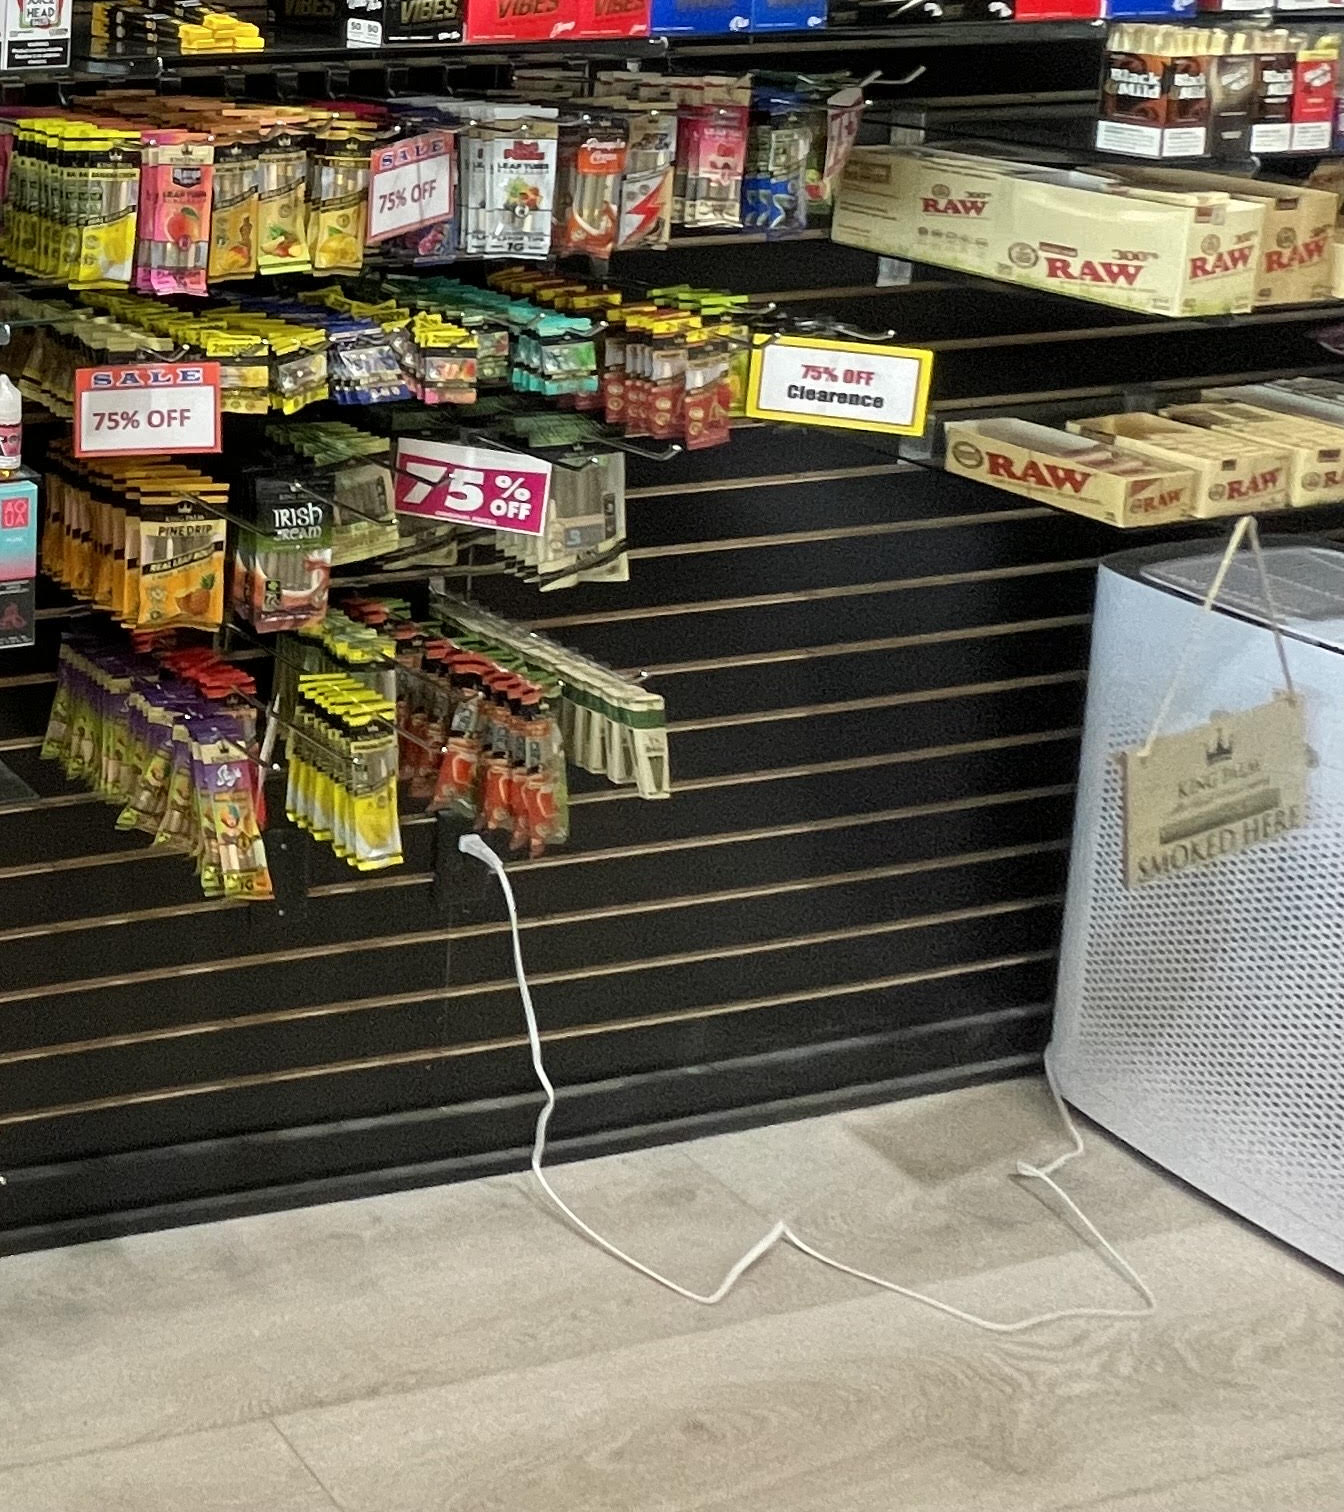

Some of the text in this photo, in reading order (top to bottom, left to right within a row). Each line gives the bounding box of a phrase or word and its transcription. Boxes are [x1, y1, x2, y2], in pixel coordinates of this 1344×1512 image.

[381, 139, 445, 168] SALE
[379, 179, 438, 213] 75% OFF
[920, 196, 989, 216] RAW
[1046, 257, 1145, 286] RAW
[1189, 246, 1255, 280] RAW
[91, 369, 203, 386] SALE
[800, 365, 874, 387] 75% OFF
[787, 385, 884, 409] Clearence
[92, 409, 191, 431] 75% OFF
[986, 452, 1092, 493] RAW
[1226, 469, 1284, 500] RAW
[273, 503, 323, 528] IRISH
[490, 500, 532, 520] OFF
